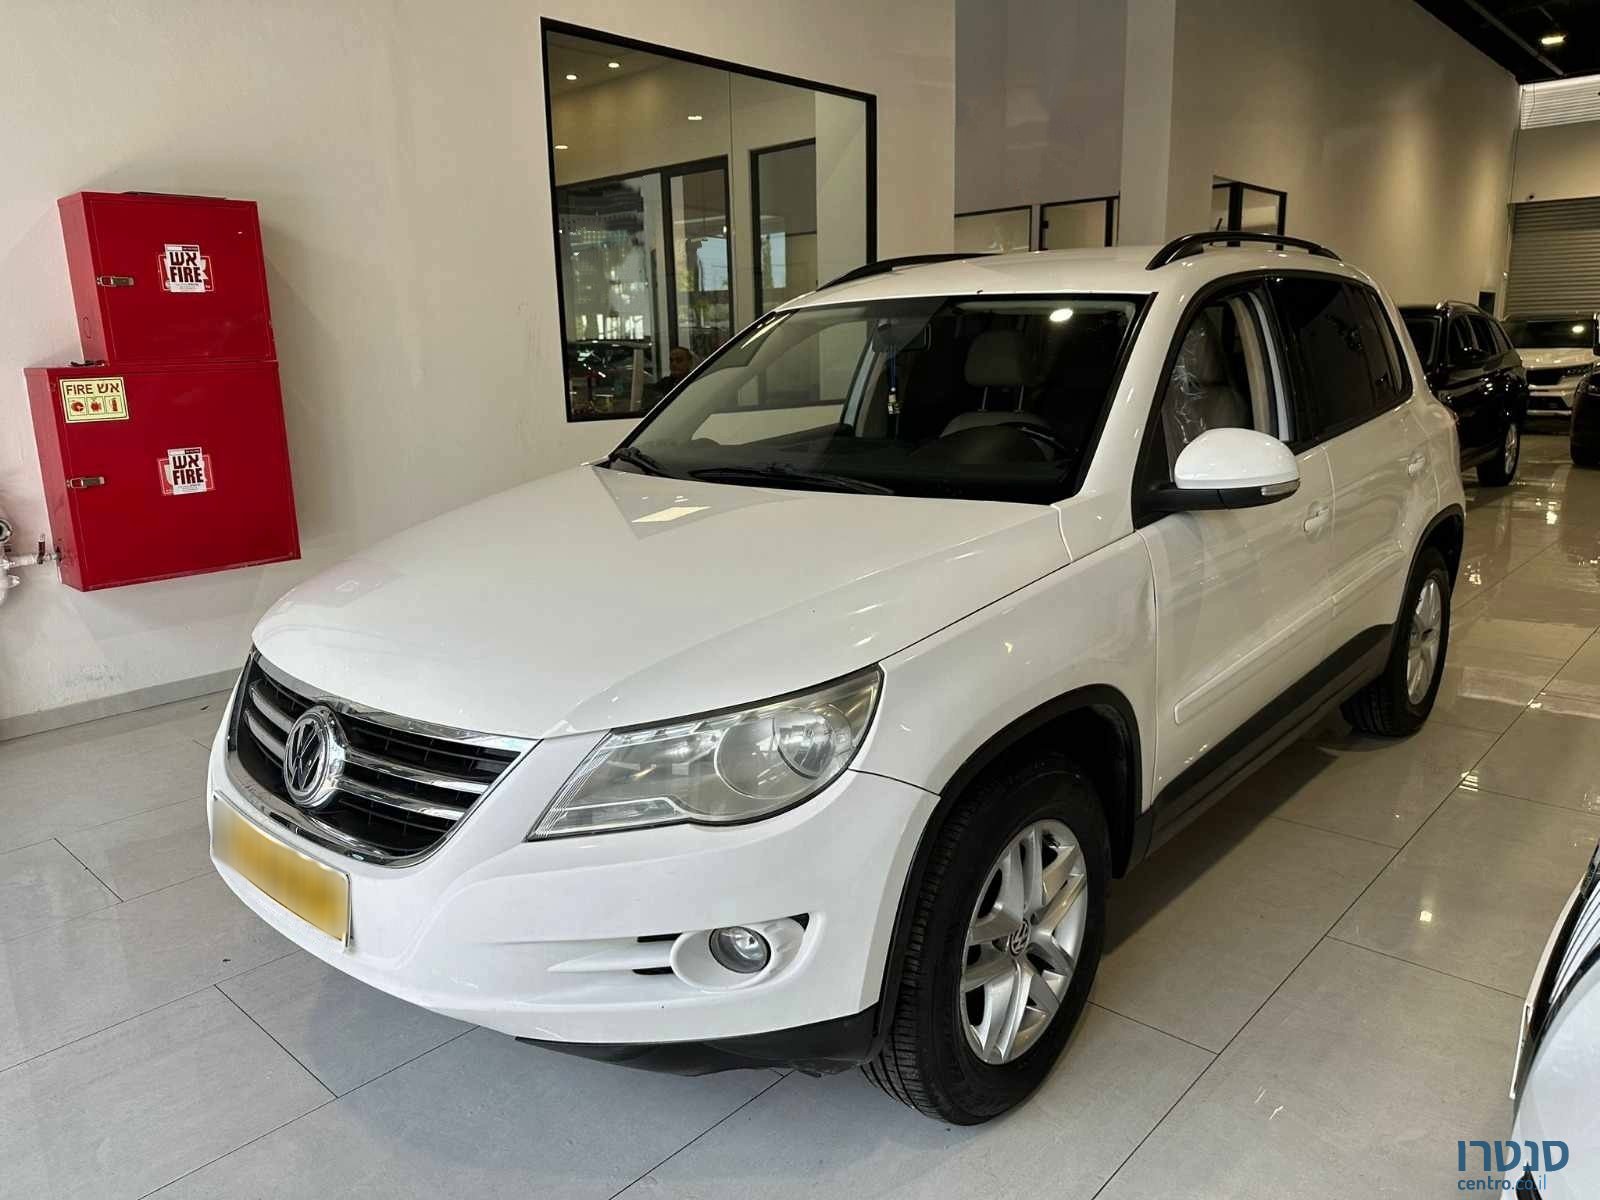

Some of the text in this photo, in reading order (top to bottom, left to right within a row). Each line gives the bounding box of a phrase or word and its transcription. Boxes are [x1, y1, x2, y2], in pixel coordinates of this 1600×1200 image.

[169, 251, 198, 266] אש
[169, 266, 203, 283] FIRE
[66, 383, 120, 395] FIRE אש
[172, 454, 200, 469] אש
[172, 467, 204, 485] FIRE
